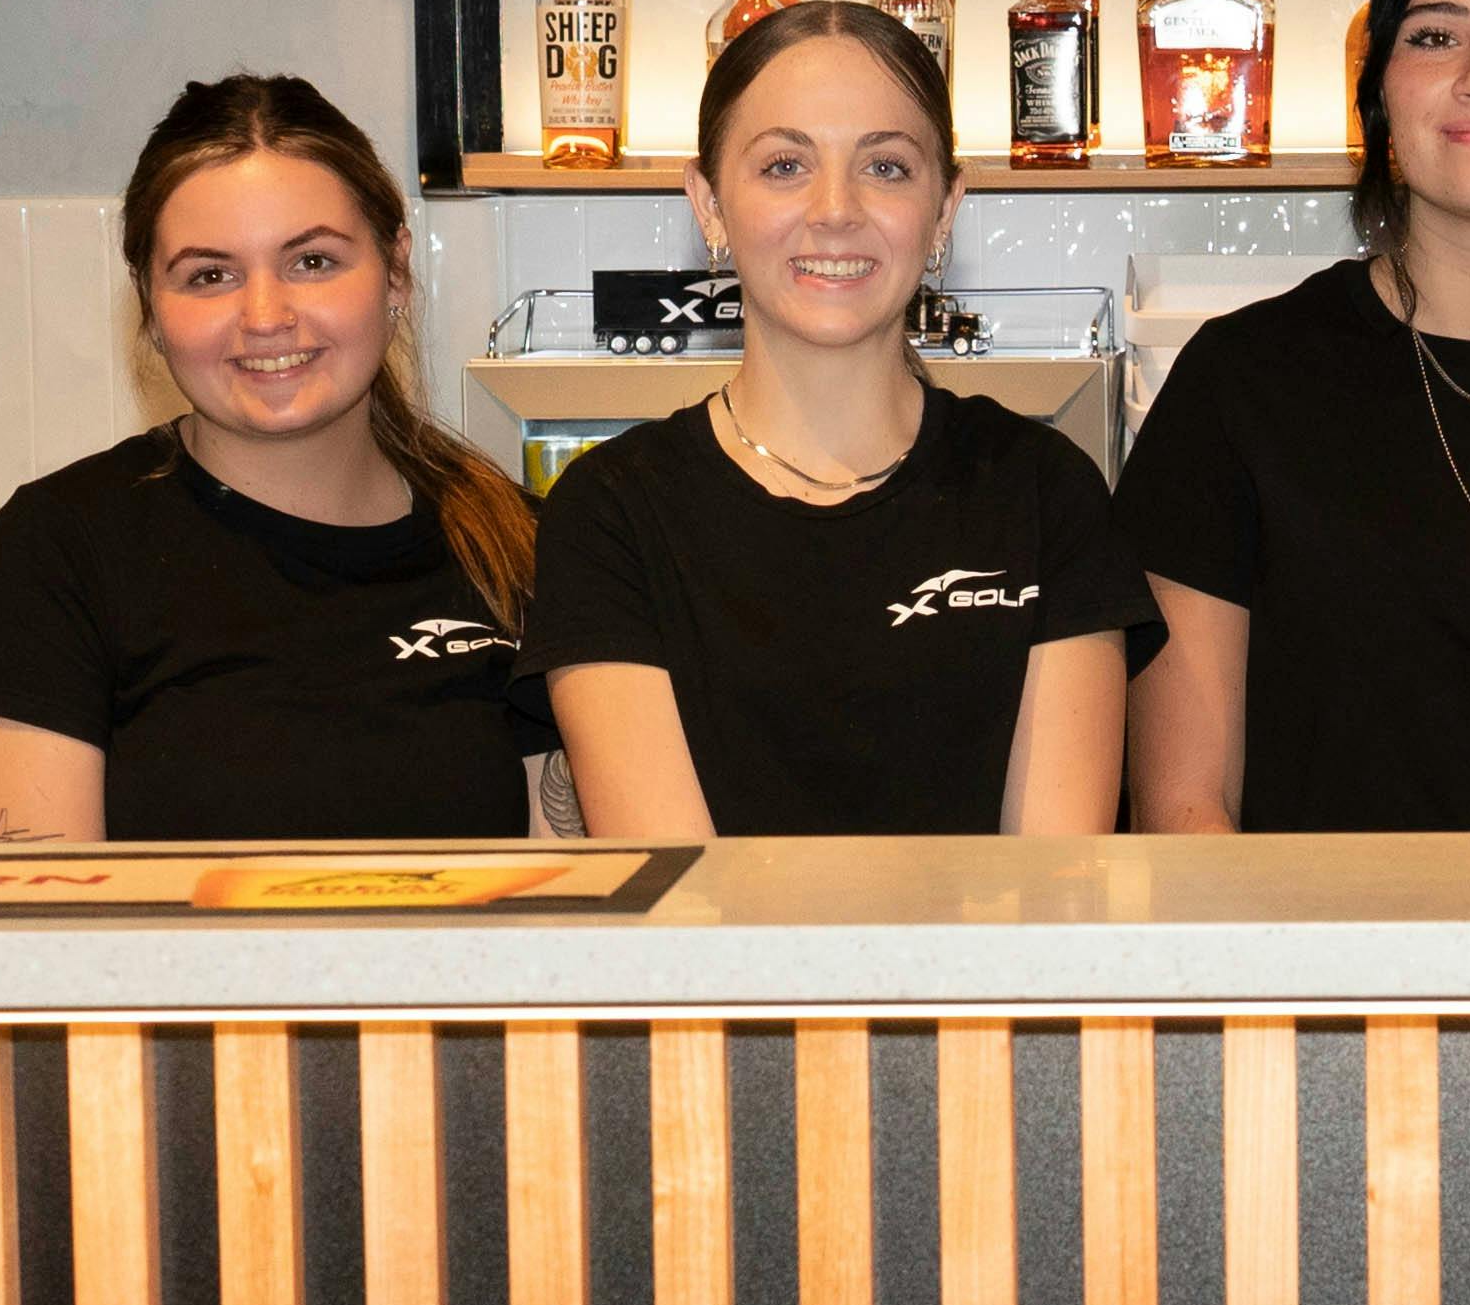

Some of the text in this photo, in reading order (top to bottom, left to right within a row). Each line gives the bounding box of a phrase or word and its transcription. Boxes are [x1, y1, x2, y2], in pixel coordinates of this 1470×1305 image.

[545, 11, 617, 43] SHEEP
[546, 44, 618, 79] DG
[1014, 46, 1040, 68] JACK
[561, 94, 602, 106] Whikey
[658, 298, 705, 323] X
[886, 585, 1039, 627] X GOLF
[389, 635, 522, 659] X GOL
